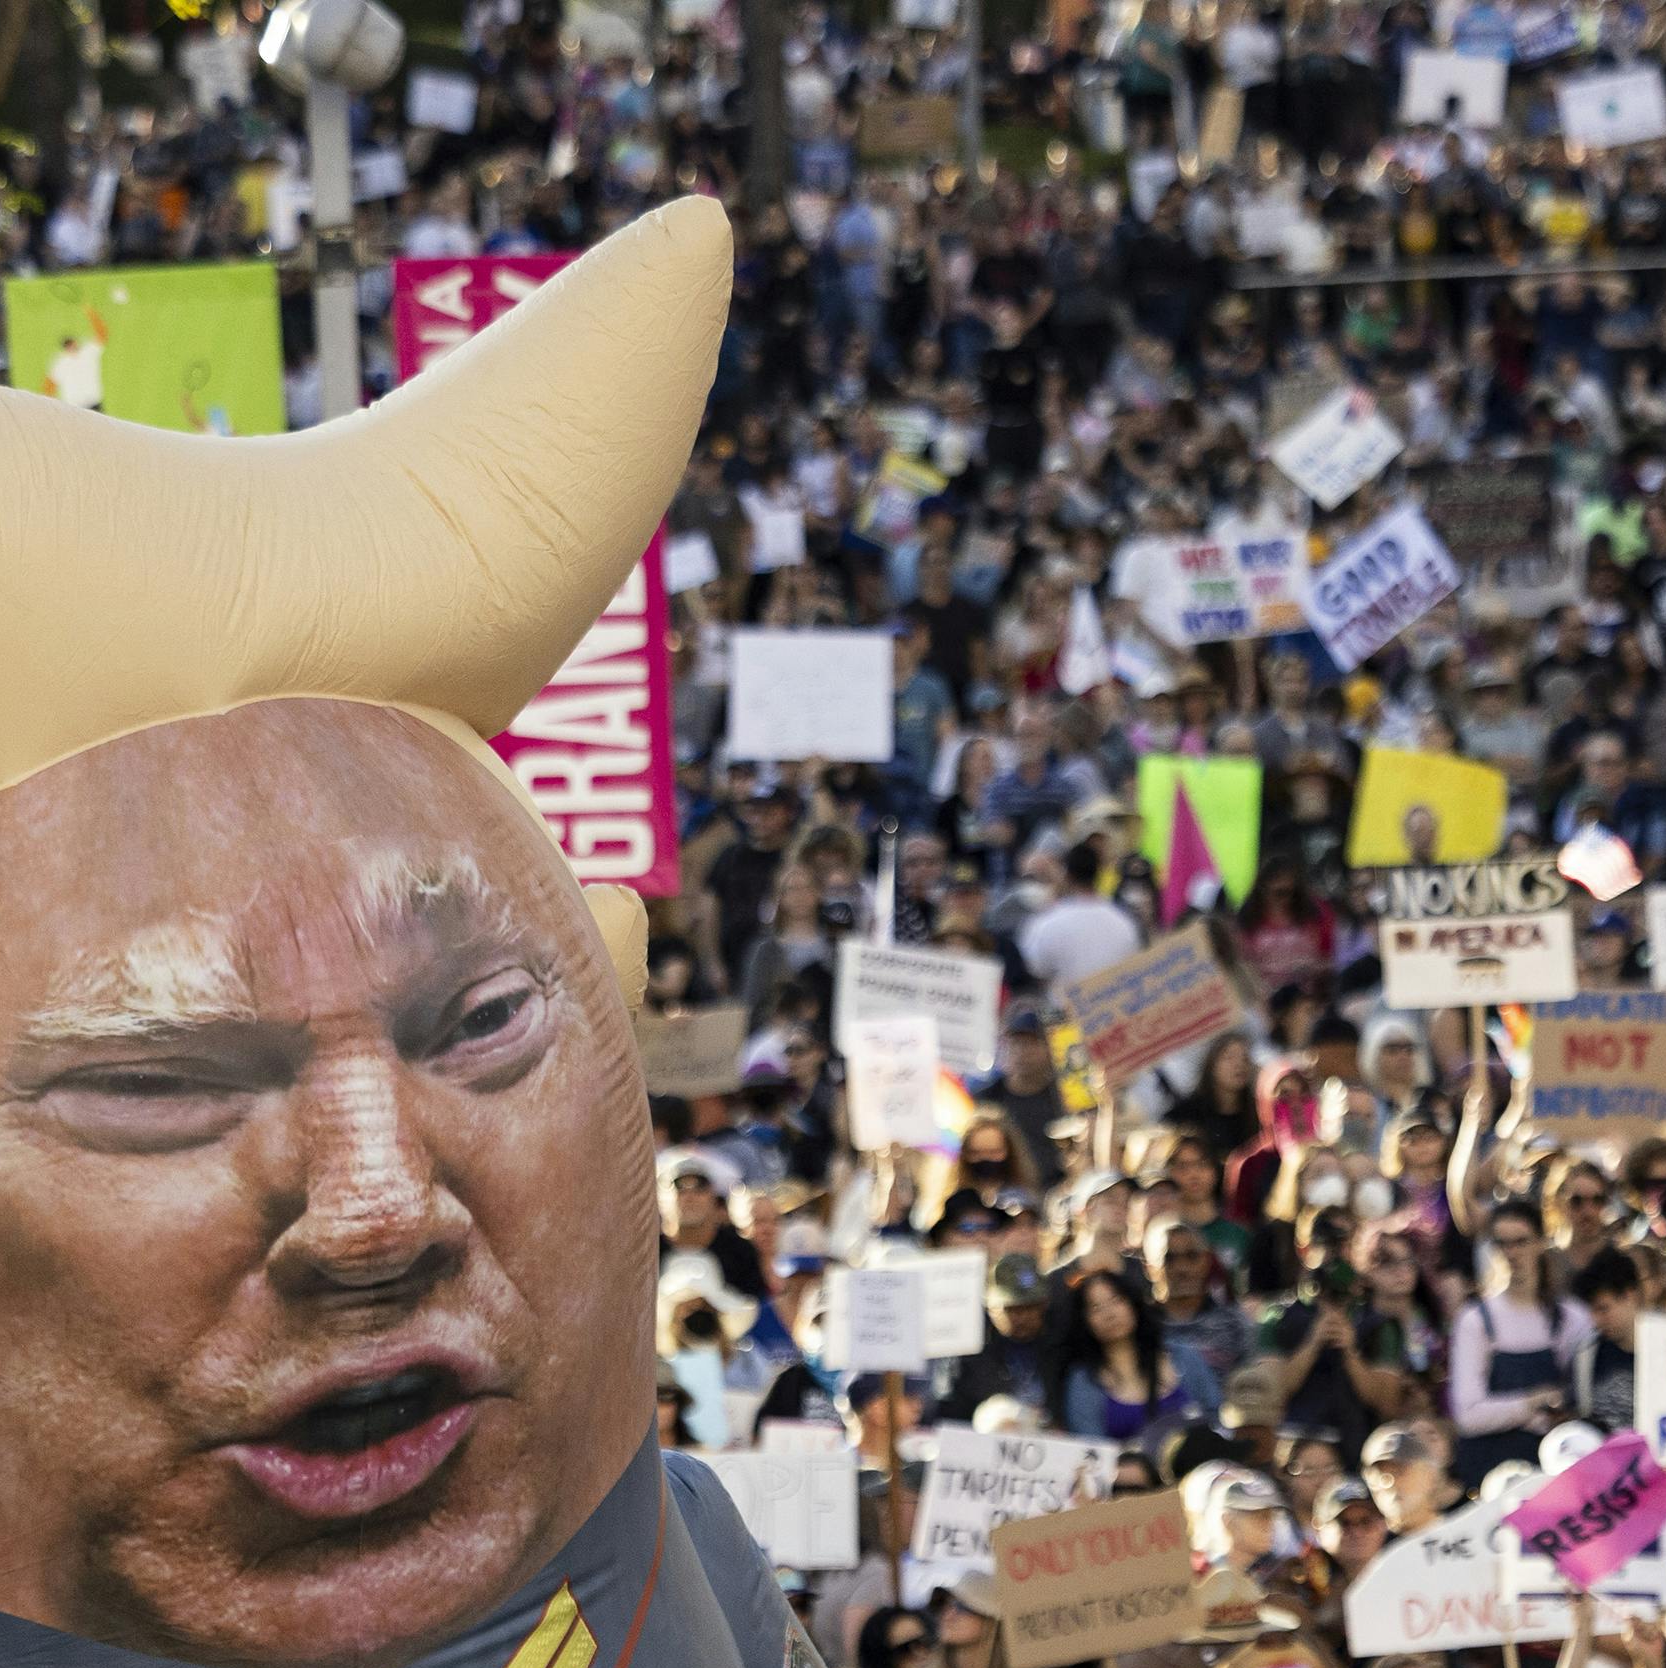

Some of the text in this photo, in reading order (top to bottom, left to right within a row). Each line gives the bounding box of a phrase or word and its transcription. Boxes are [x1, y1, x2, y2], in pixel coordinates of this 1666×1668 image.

[1561, 1030, 1654, 1072] NOT
[997, 1440, 1048, 1473] NO
[936, 1467, 1063, 1514] TARIFFS
[1532, 1455, 1651, 1560] RESIST
